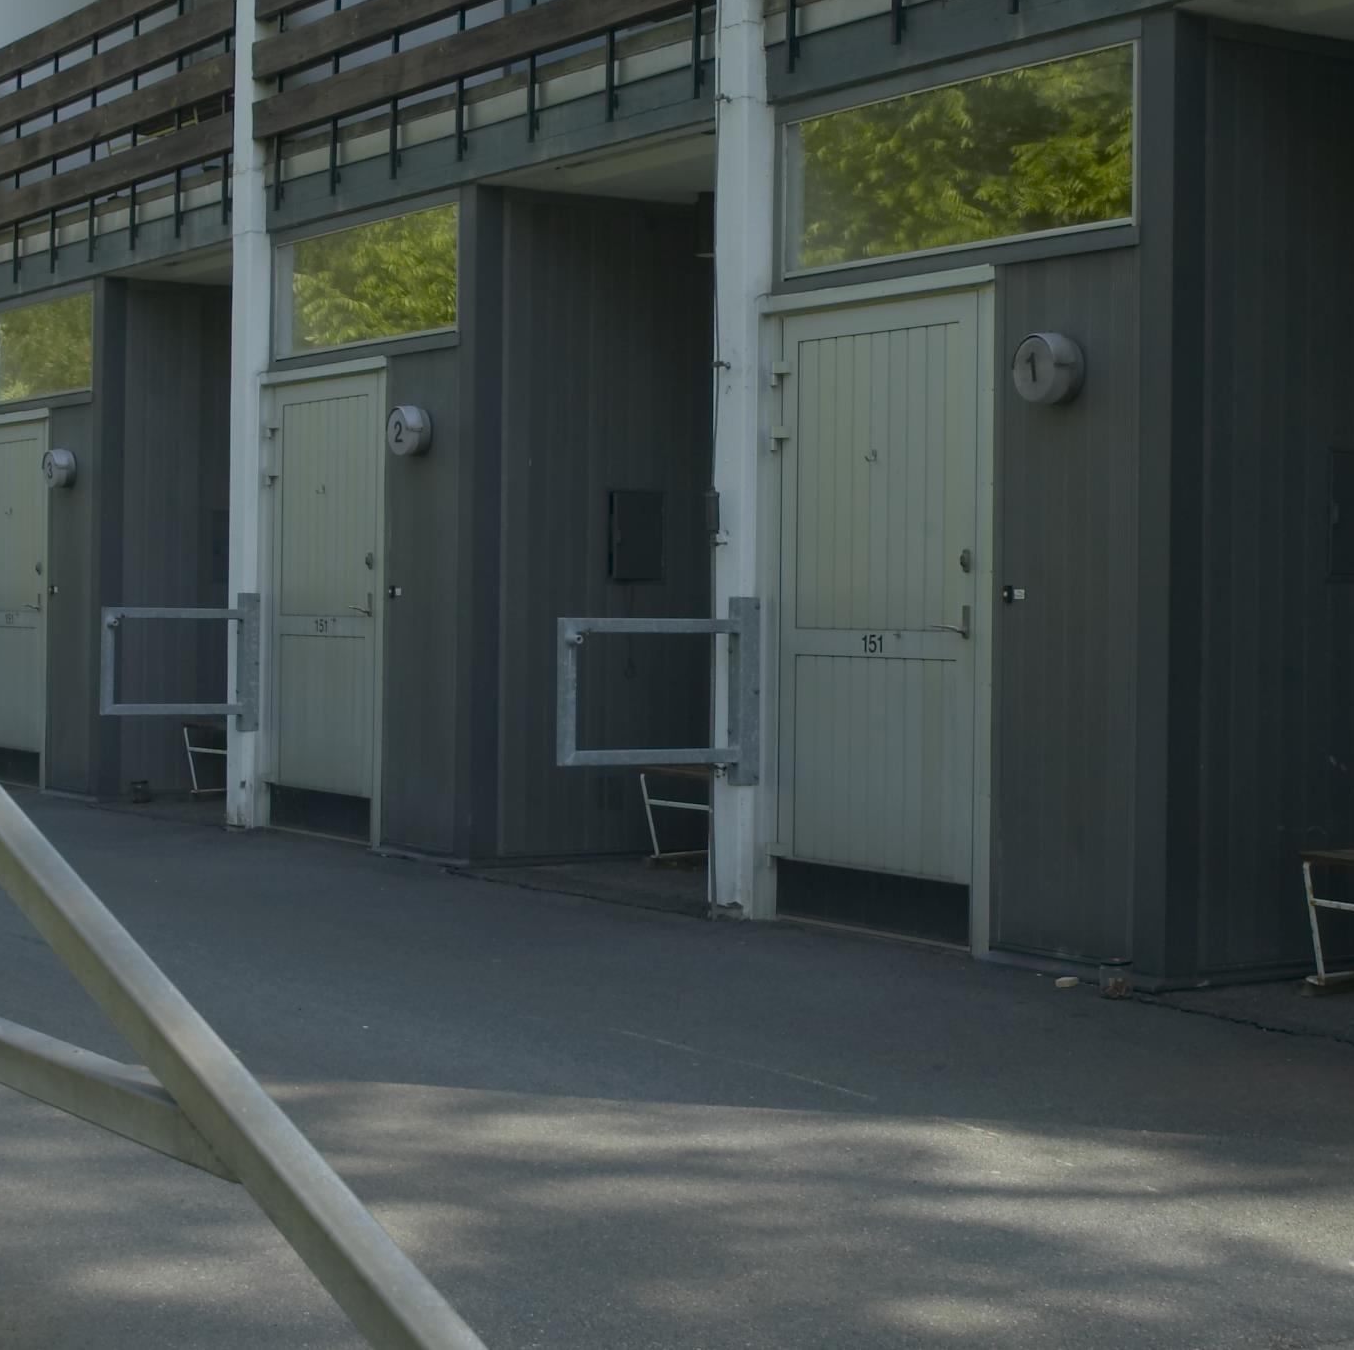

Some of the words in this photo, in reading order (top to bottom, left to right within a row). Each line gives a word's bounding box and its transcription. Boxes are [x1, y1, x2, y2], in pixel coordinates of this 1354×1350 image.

[1026, 352, 1037, 383] 1
[394, 421, 404, 443] 2
[315, 618, 328, 634] 151
[862, 634, 883, 654] 151
